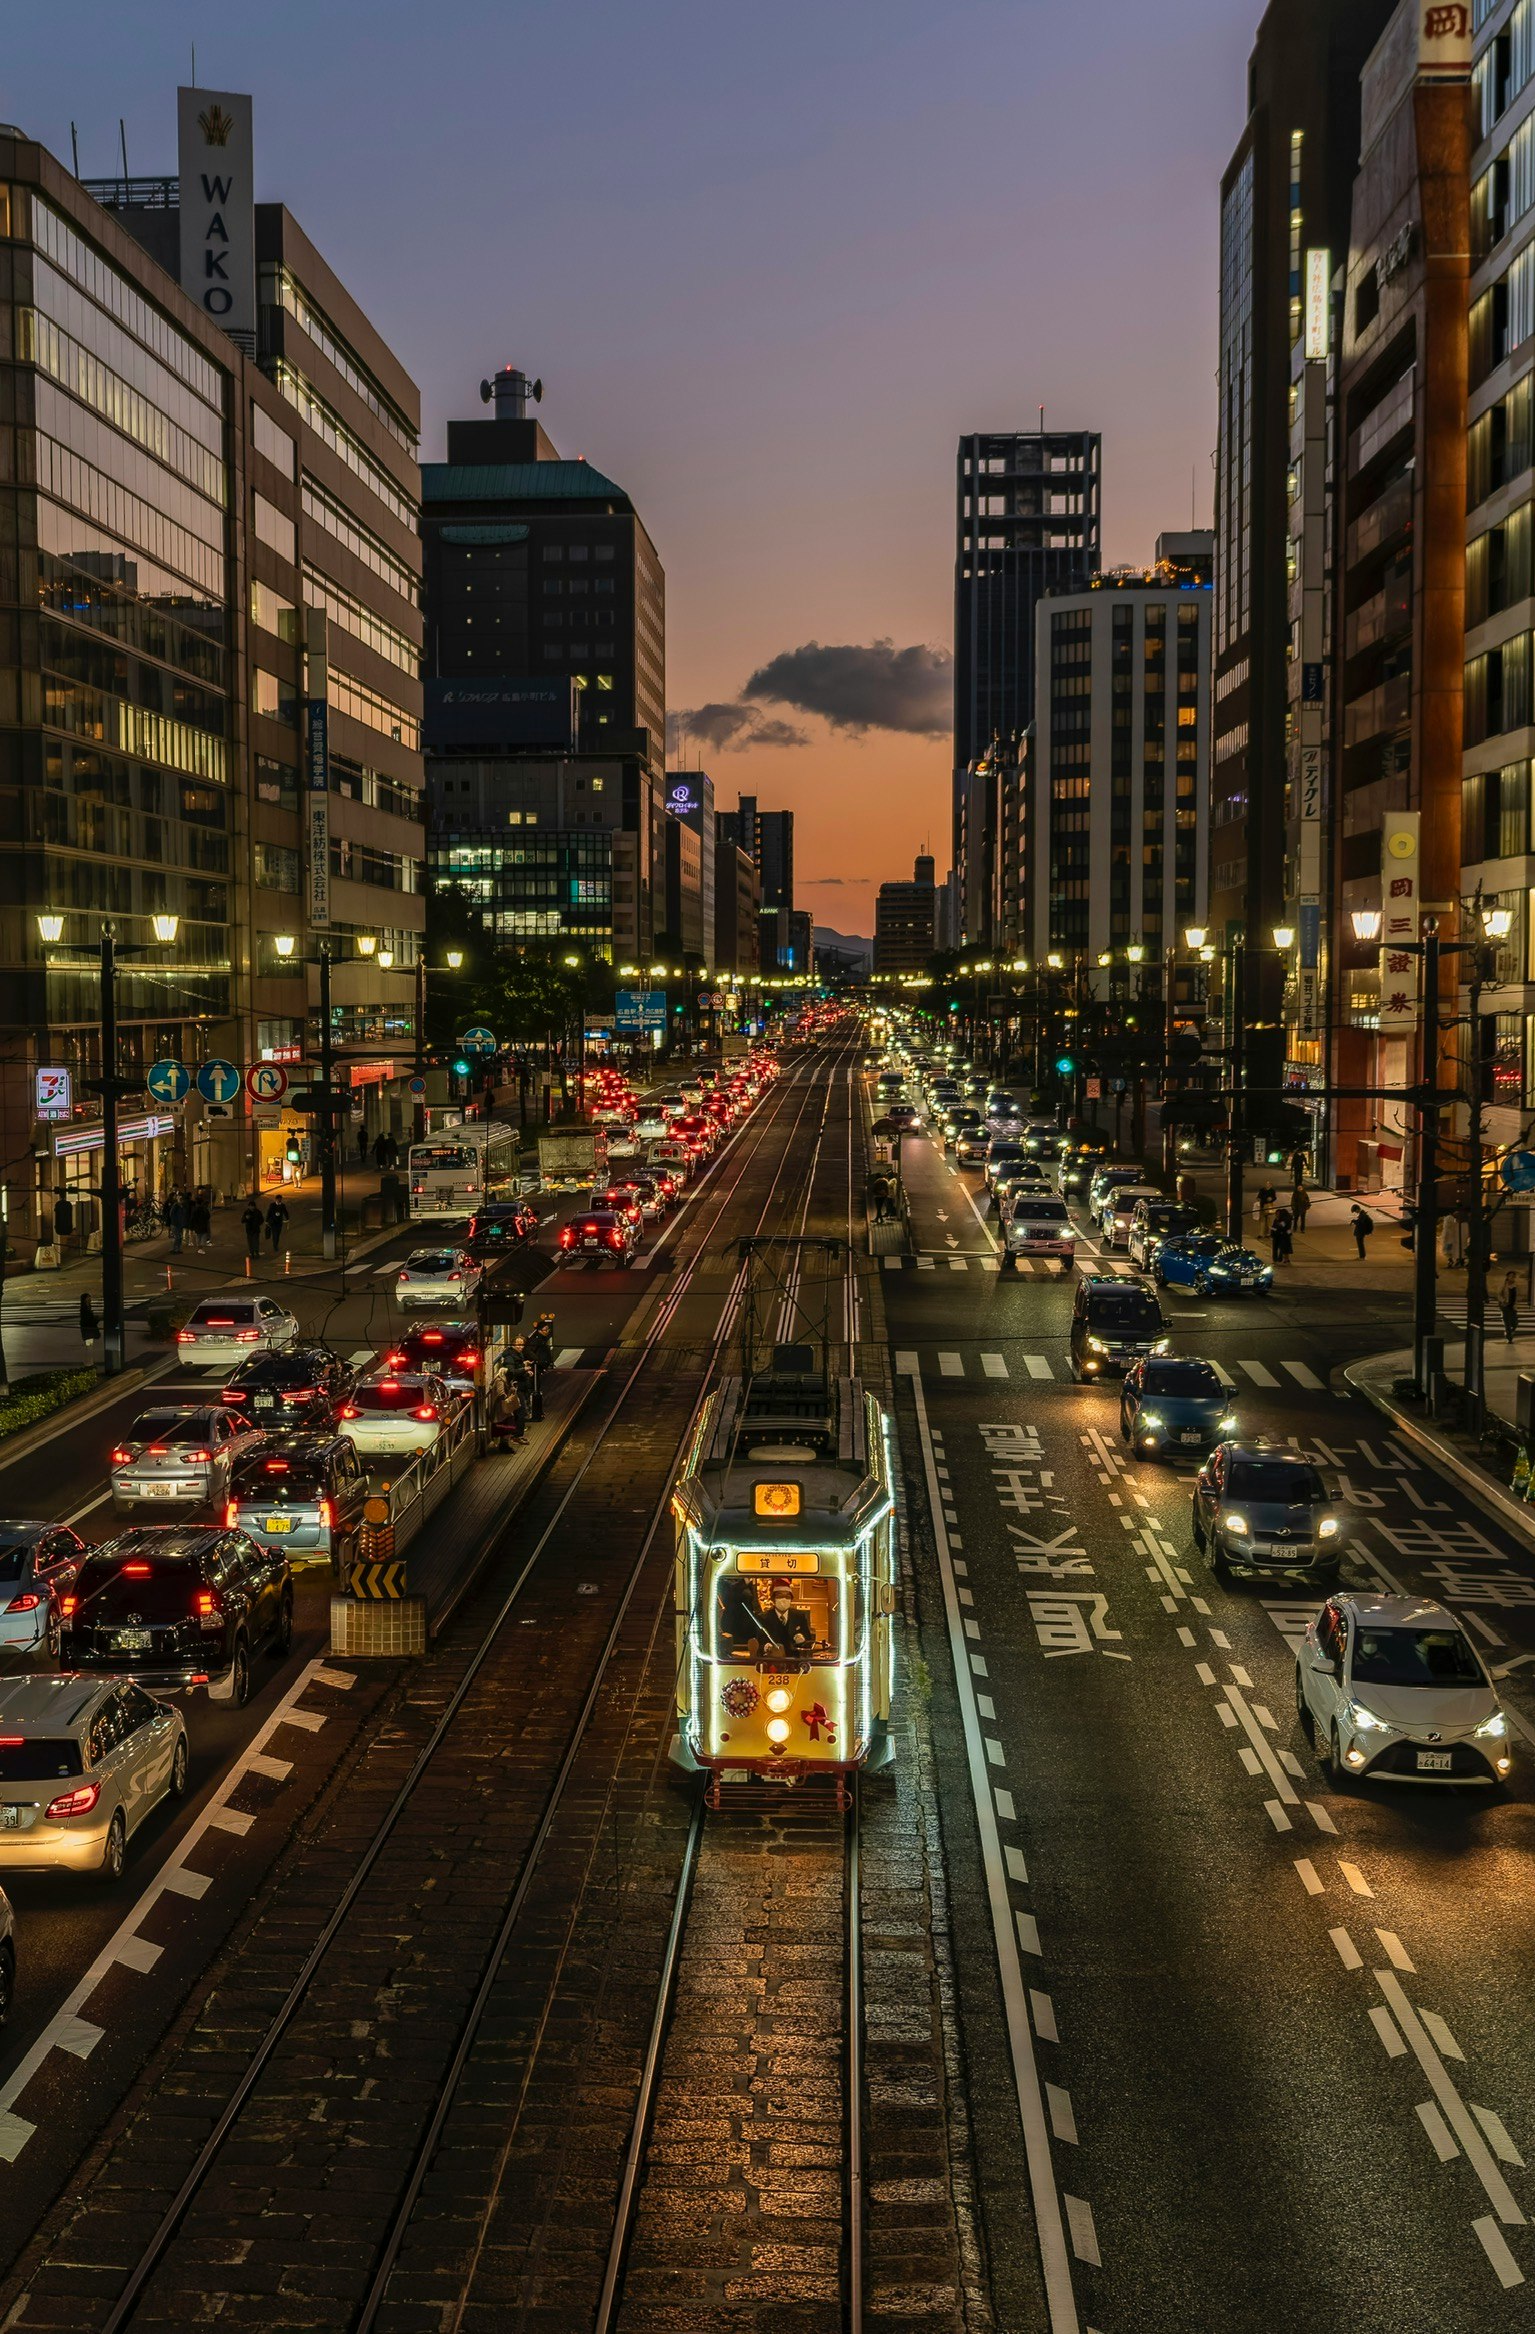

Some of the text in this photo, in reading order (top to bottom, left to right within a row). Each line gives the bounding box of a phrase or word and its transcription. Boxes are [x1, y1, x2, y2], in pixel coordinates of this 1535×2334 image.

[200, 173, 234, 315] WAKO
[312, 810, 327, 902] 東洋紡株式会社
[768, 1675, 790, 1686] 238
